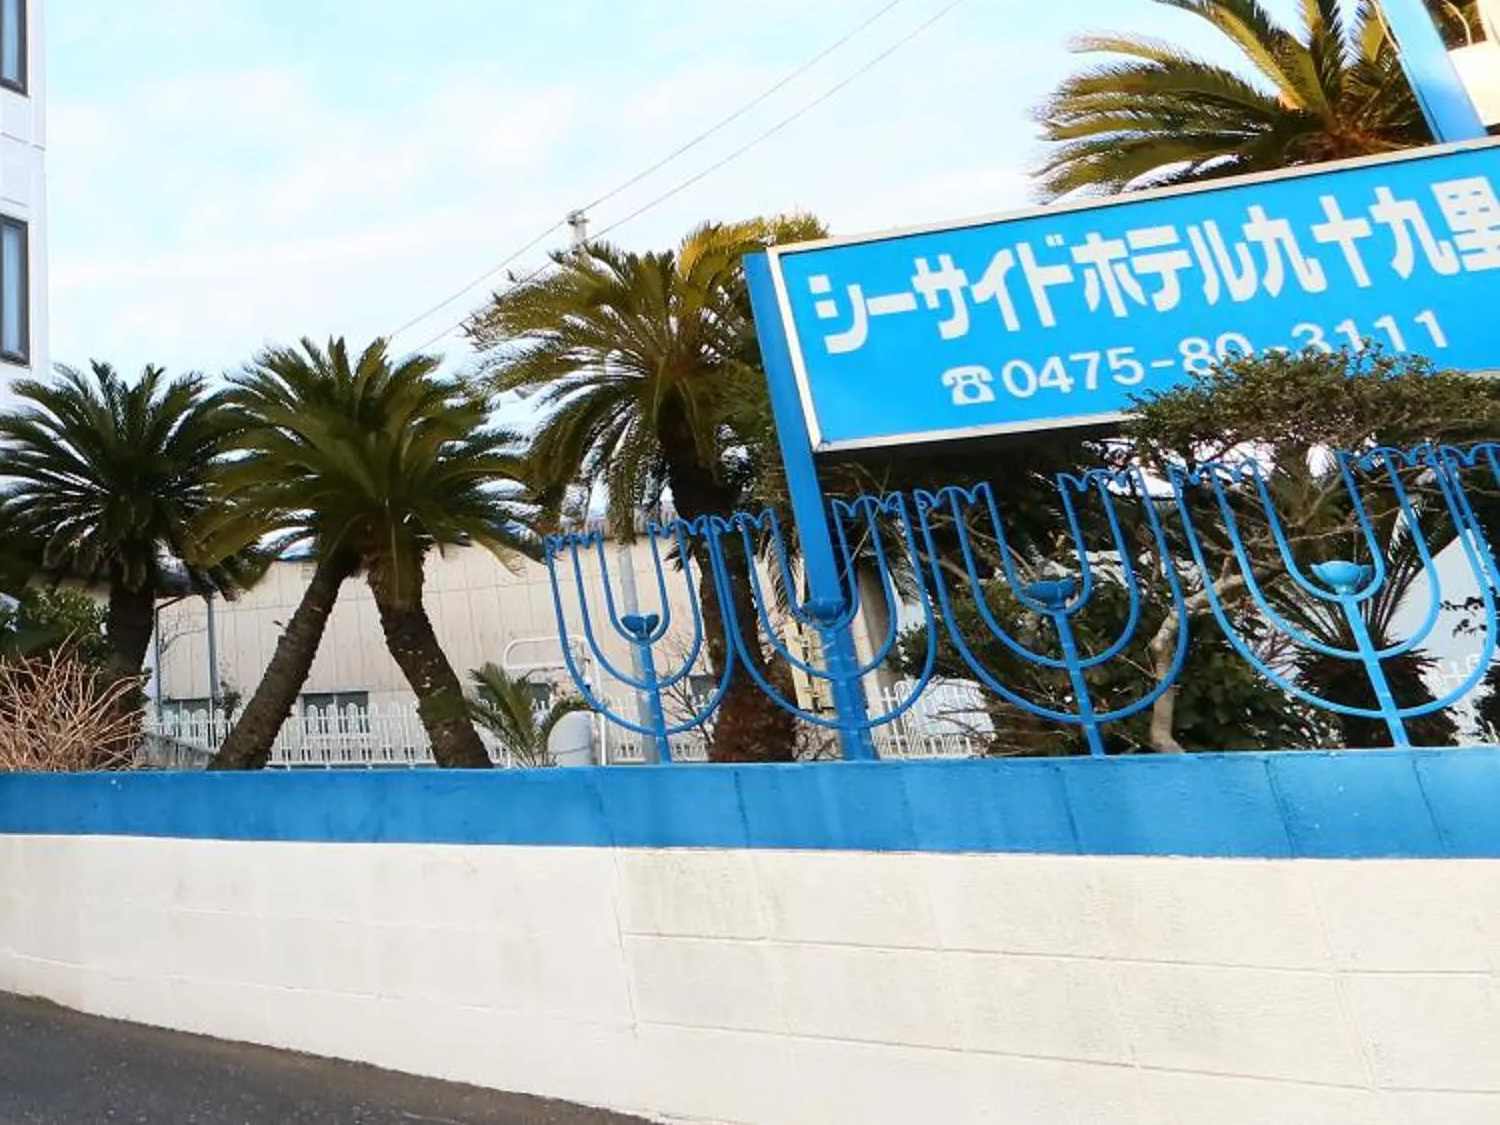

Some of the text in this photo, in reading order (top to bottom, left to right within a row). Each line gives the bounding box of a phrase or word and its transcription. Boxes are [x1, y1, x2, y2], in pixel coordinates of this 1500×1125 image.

[809, 176, 1500, 354] シーサイドホテル九十九里
